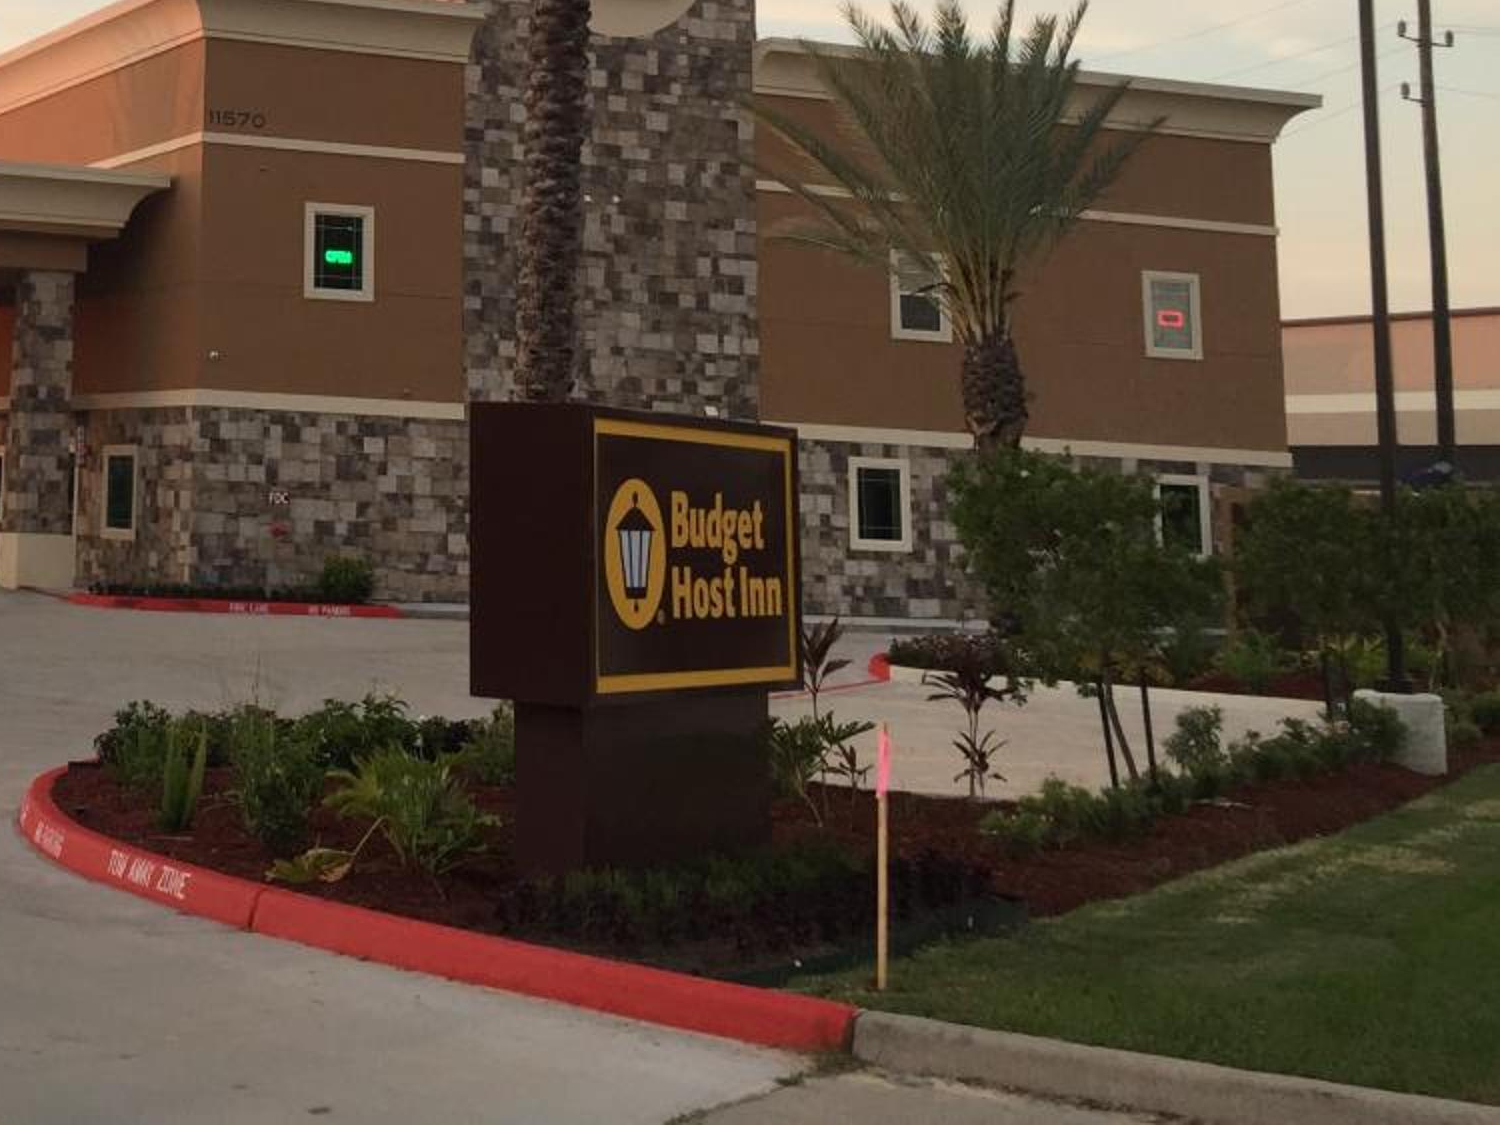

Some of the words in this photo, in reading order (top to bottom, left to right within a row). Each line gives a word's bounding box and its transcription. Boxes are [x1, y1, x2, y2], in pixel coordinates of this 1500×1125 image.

[209, 110, 266, 128] 11570
[671, 490, 765, 565] Budget
[671, 566, 736, 619] Host
[740, 566, 783, 617] Inn
[156, 864, 191, 900] ZONE
